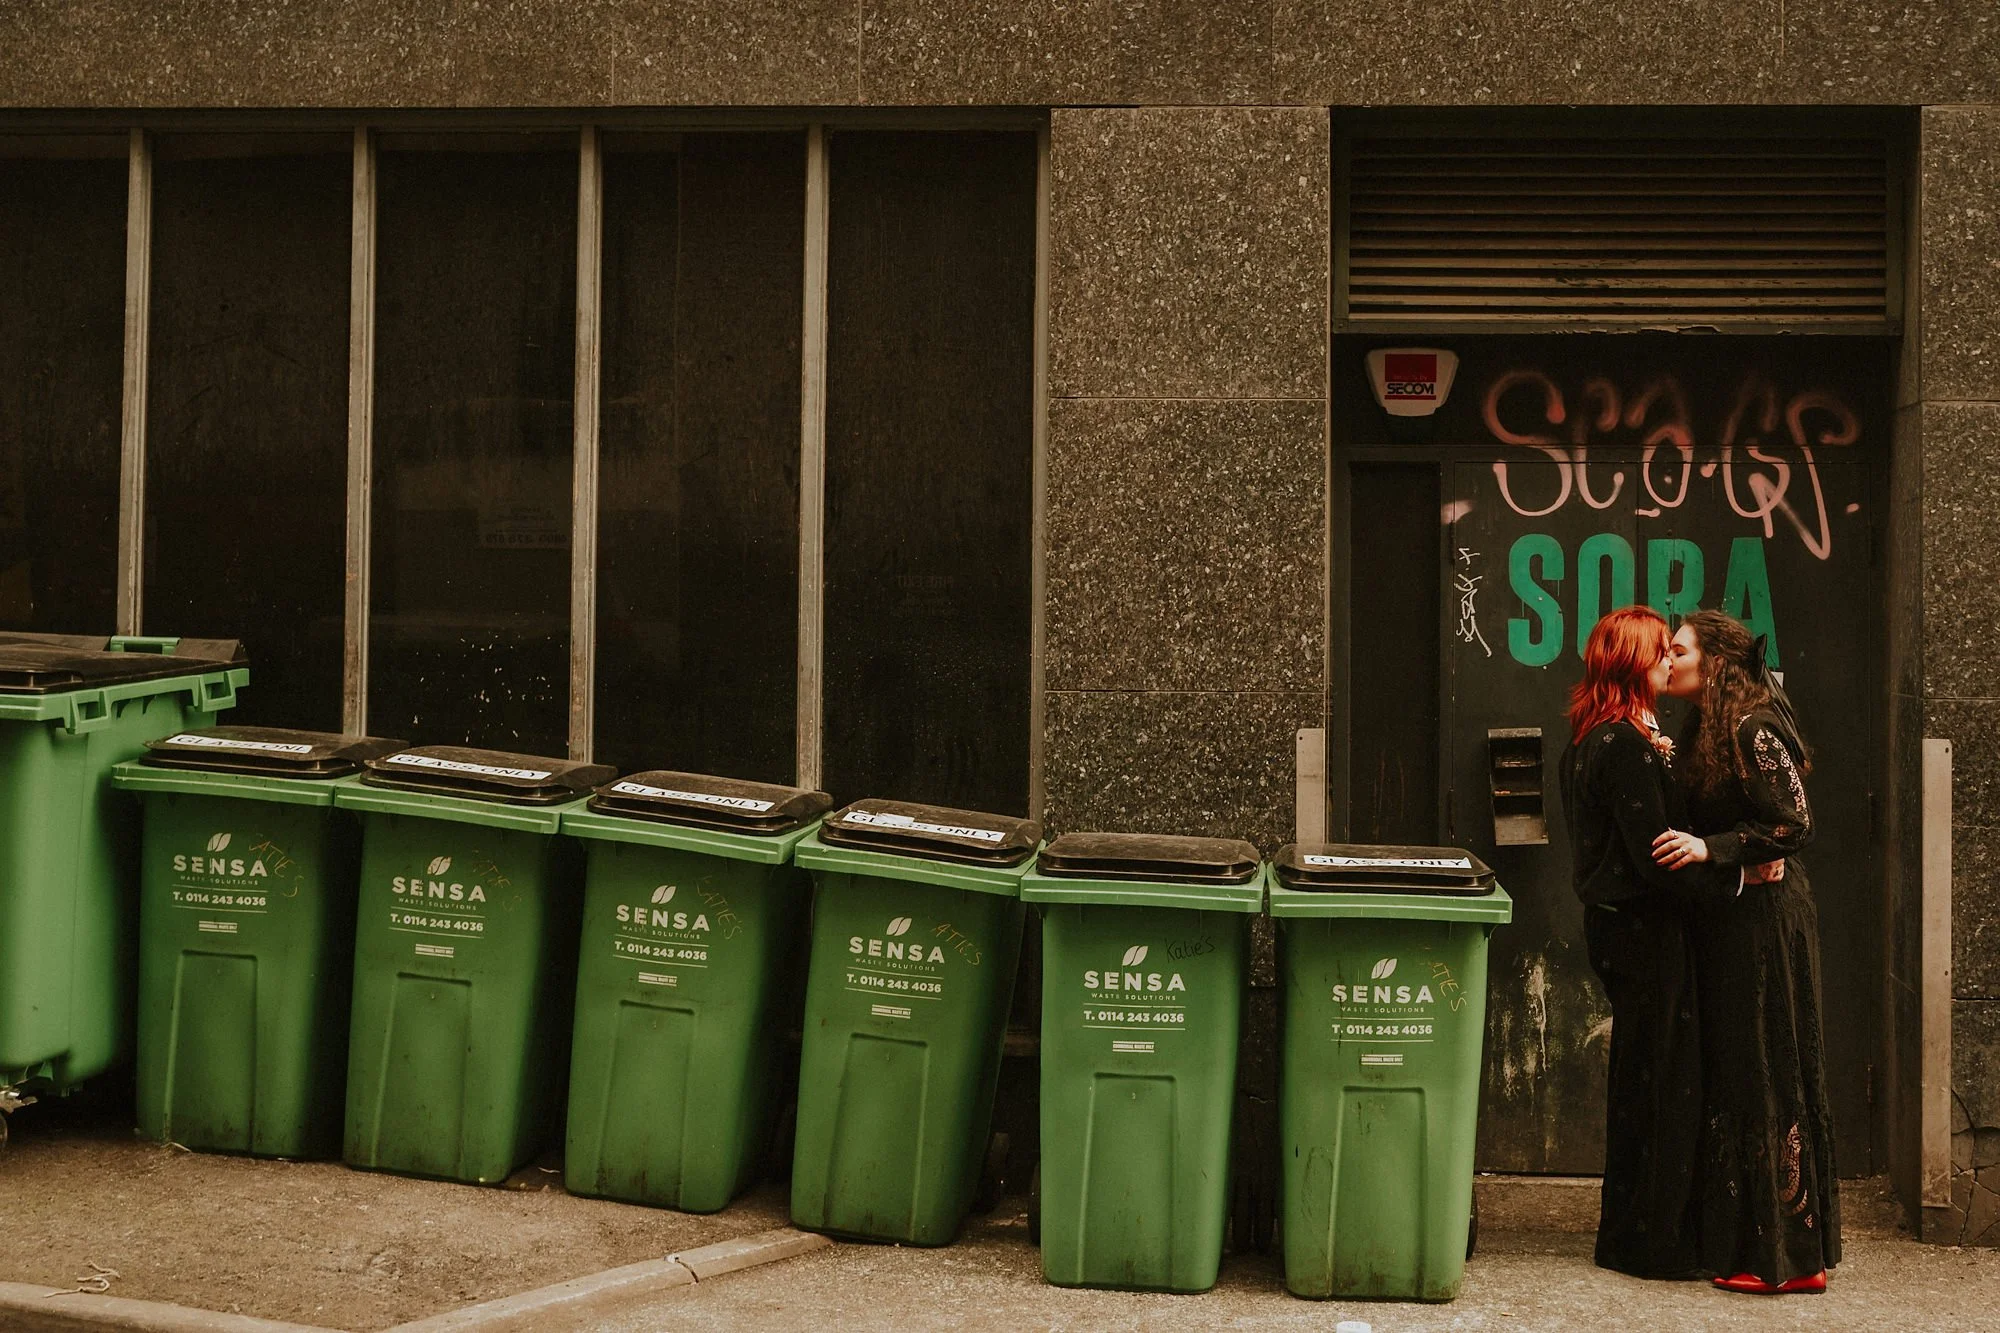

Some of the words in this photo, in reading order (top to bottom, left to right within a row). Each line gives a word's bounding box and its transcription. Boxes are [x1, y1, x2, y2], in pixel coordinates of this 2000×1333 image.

[1387, 383, 1434, 395] SECOM
[397, 756, 472, 770] GLASS
[621, 785, 698, 799] GLASS
[705, 797, 768, 808] ONLY
[937, 827, 998, 838] ONLY
[173, 854, 268, 877] SENSA
[1310, 857, 1391, 866] GLASS
[392, 877, 486, 902] SENSA
[173, 891, 183, 901] T.
[186, 892, 209, 903] 0114
[212, 894, 233, 905] 243
[236, 896, 266, 906] 4036
[429, 901, 476, 910] SOLUTIONS
[390, 913, 400, 924] T.
[403, 915, 427, 926] 0114
[430, 917, 451, 929] 243
[453, 920, 483, 932] 4036
[616, 904, 710, 932] SENSA
[652, 930, 700, 940] SOLUTIONS
[614, 941, 624, 952] T.
[627, 943, 650, 955] 0114
[653, 946, 674, 958] 243
[677, 949, 707, 961] 4036
[849, 936, 945, 964] SENSA
[887, 962, 935, 972] SOLUTIONS
[846, 973, 857, 983] T.
[860, 975, 884, 987] 0114
[887, 978, 908, 990] 243
[911, 981, 942, 993] 4036
[1084, 970, 1186, 991] SENSA
[1332, 984, 1434, 1004] SENSA
[1083, 1010, 1095, 1020] T.
[1098, 1011, 1124, 1022] 0114
[1127, 1012, 1149, 1022] 243
[1152, 1013, 1184, 1023] 4036
[1332, 1024, 1343, 1034] T.
[1346, 1025, 1373, 1035] 0114
[1376, 1025, 1398, 1035] 243
[1401, 1025, 1433, 1035] 4036
